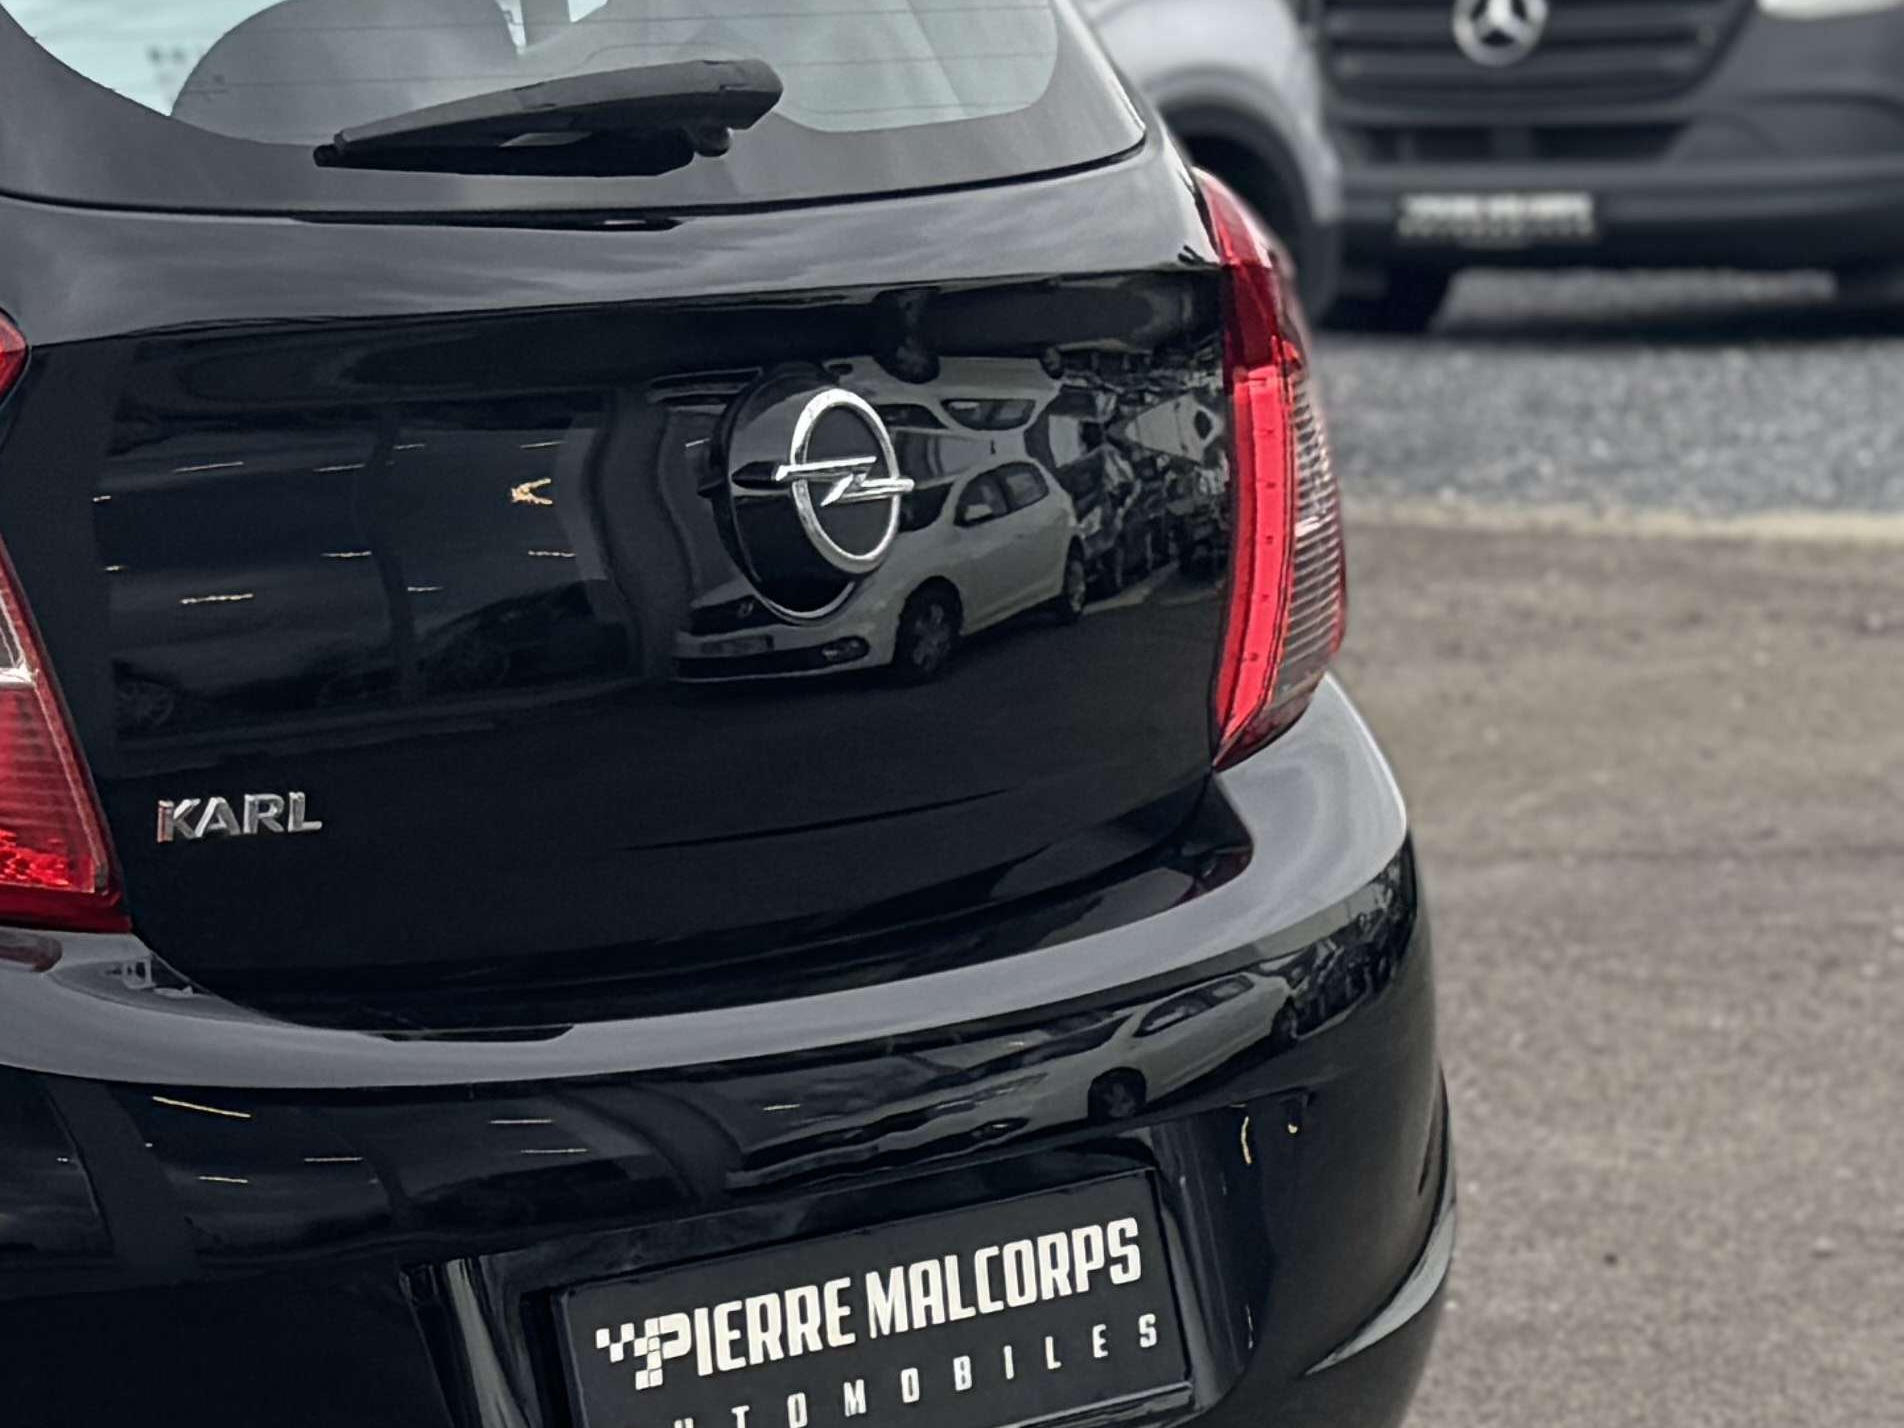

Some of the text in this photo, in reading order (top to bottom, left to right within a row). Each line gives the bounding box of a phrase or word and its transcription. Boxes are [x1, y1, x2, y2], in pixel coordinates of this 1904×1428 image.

[157, 791, 323, 843] KARL
[628, 1218, 1142, 1390] PIERRE MALCORPS
